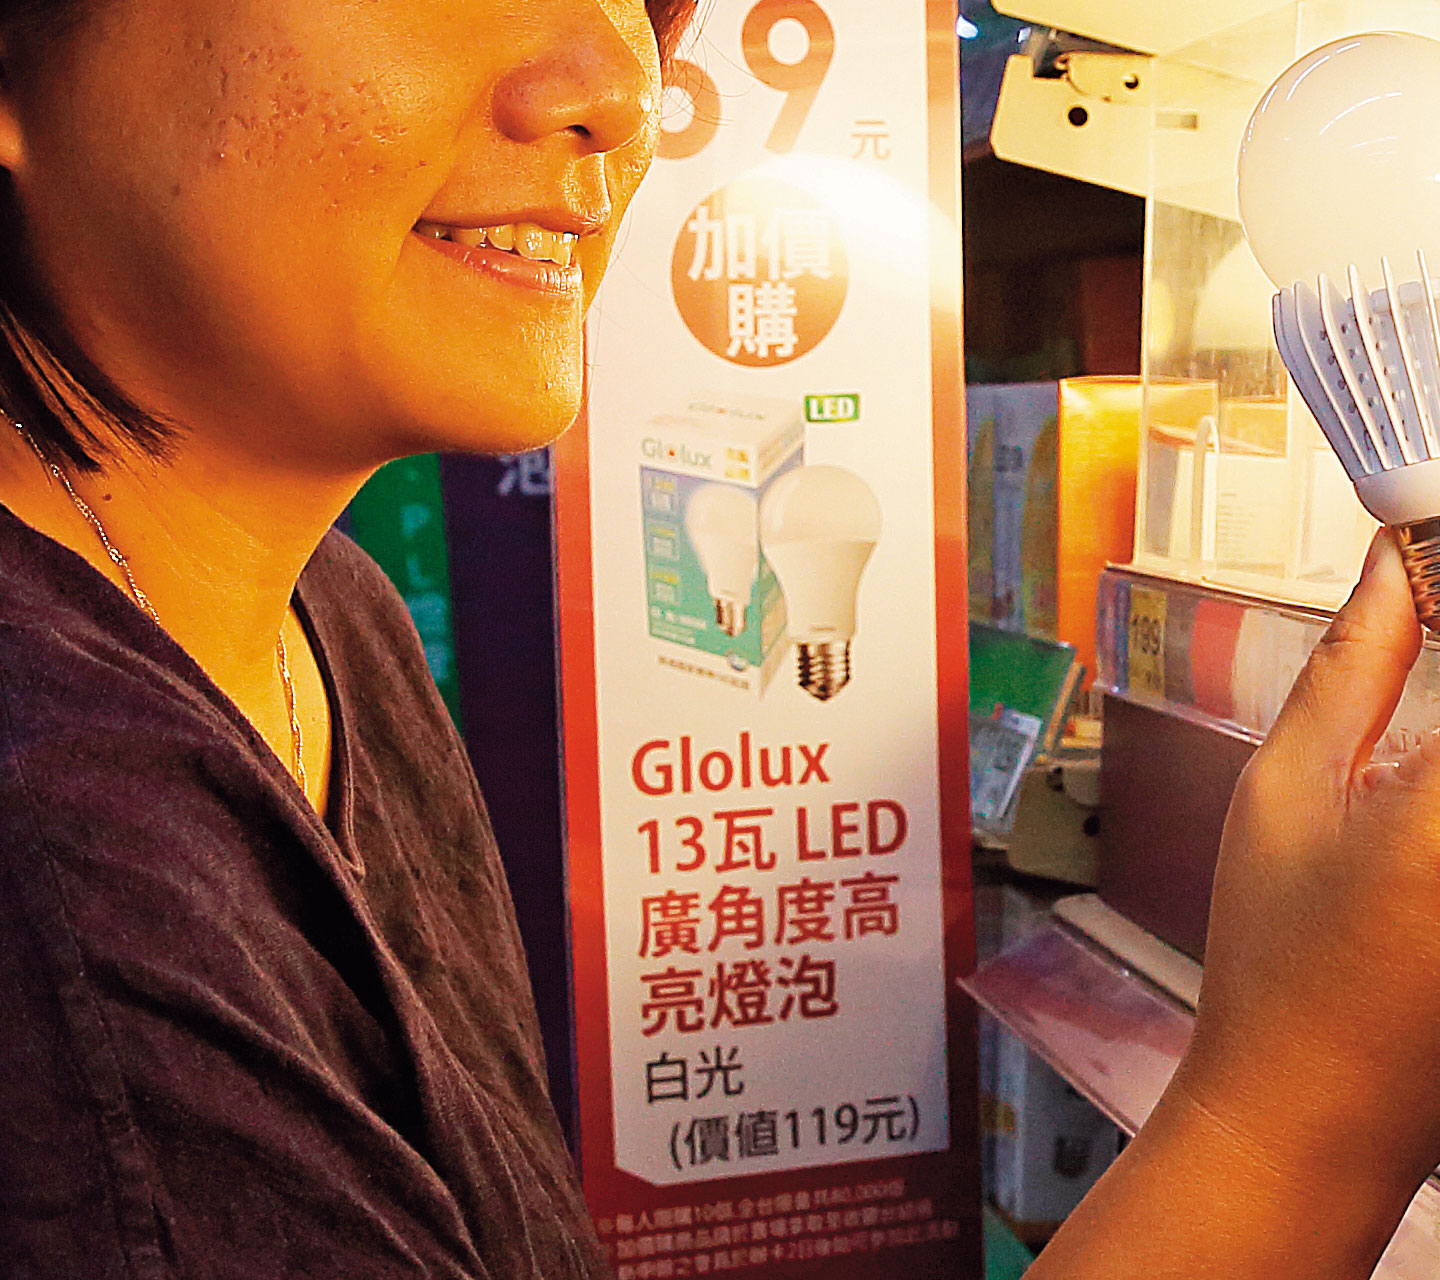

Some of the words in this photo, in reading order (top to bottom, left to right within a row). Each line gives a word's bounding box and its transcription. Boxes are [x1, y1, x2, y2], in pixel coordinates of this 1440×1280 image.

[852, 119, 891, 161] 元
[688, 205, 833, 281] 加價
[727, 282, 799, 358] 購
[810, 397, 855, 420] LED
[632, 732, 830, 796] Glolux
[637, 808, 778, 874] 13瓦
[796, 799, 908, 862] LED
[638, 872, 900, 959] 廣角度高
[640, 954, 839, 1038] 亮燈泡
[646, 1045, 745, 1104] 白光
[669, 1095, 920, 1170] (價值119元)
